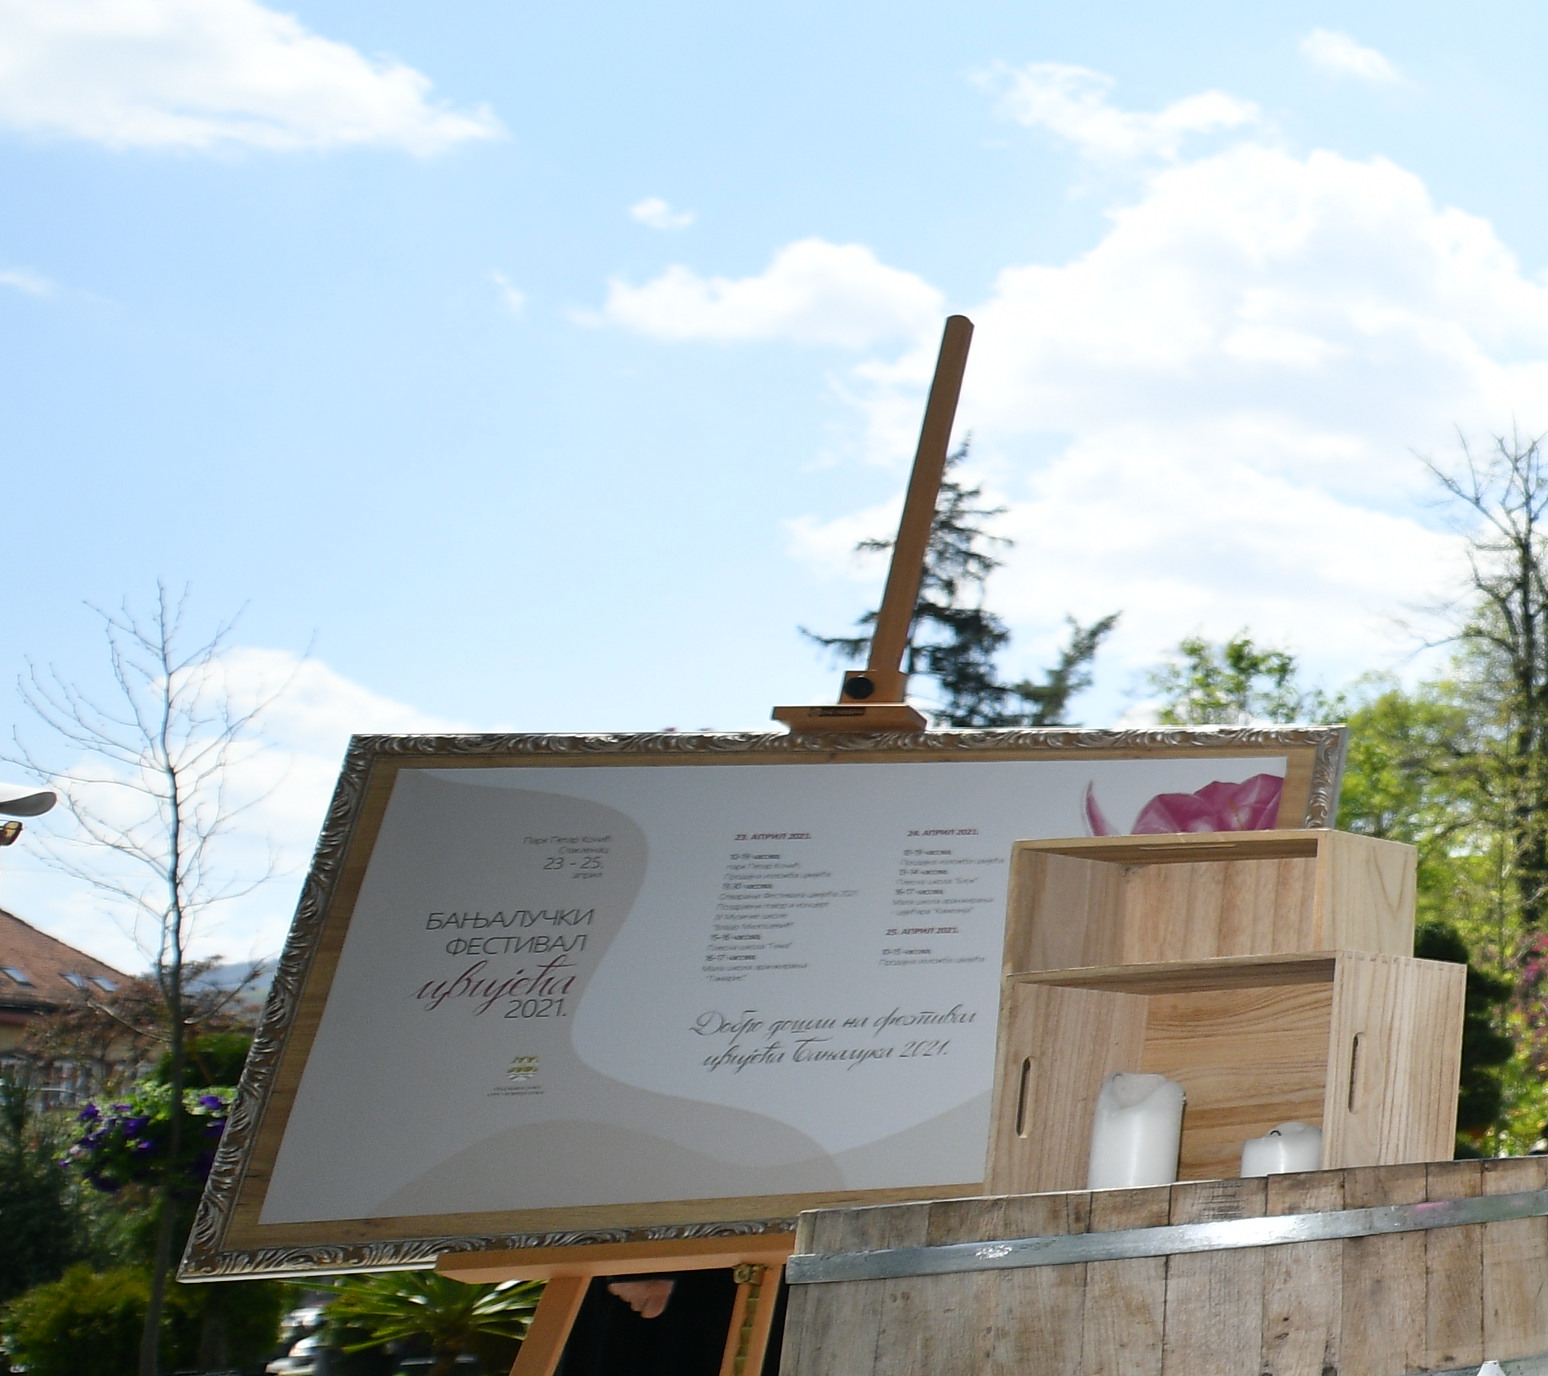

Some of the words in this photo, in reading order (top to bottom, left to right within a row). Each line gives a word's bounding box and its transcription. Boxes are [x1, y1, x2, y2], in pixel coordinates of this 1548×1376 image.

[543, 857, 565, 870] 23
[580, 856, 604, 869] 25.
[425, 908, 595, 930] БАЊАЛУЧКИ
[901, 927, 934, 935] АПРИЛ
[445, 934, 587, 956] ФЕСТИВАЛ
[409, 954, 577, 1017] цвијећа
[504, 998, 567, 1019] 2021.
[689, 1009, 763, 1045] Добро
[766, 1018, 836, 1041] дошли
[841, 1015, 868, 1029] на
[899, 1039, 951, 1058] 2021.
